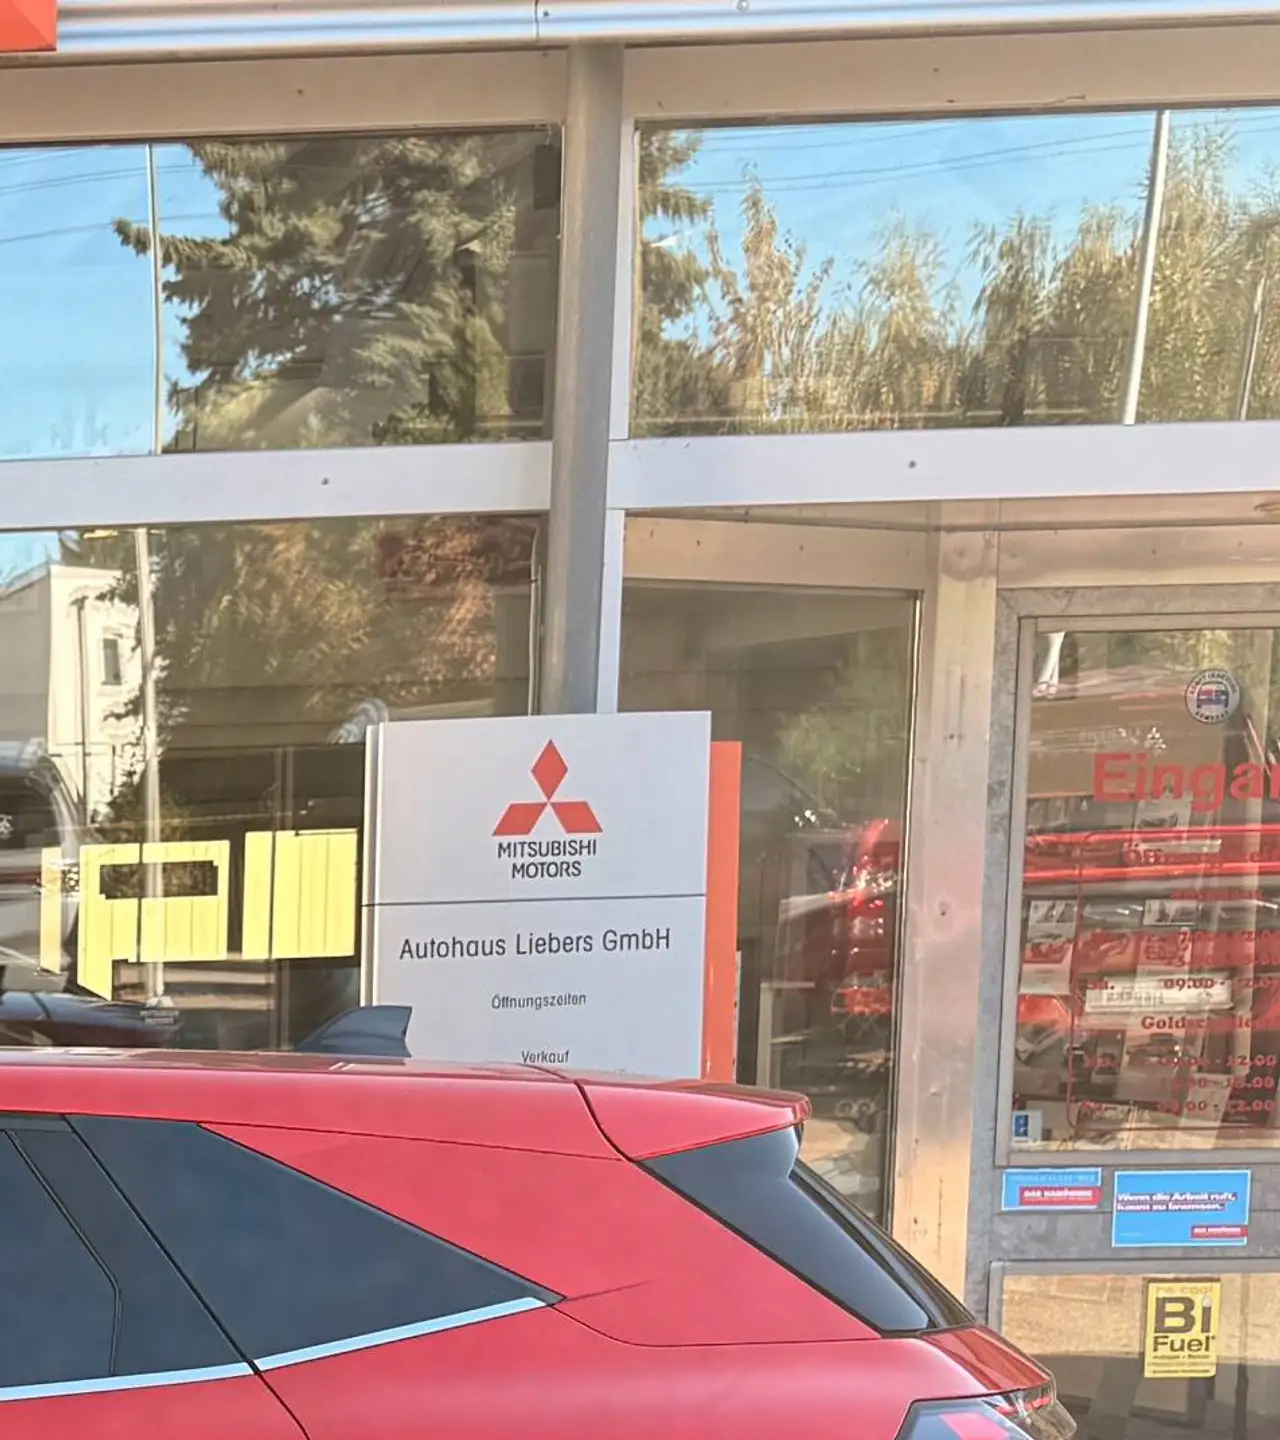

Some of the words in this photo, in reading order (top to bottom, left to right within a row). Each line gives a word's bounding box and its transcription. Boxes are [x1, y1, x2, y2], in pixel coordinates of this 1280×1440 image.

[497, 839, 597, 858] MITSUBISHI
[511, 860, 582, 879] MOTORS
[399, 936, 506, 960] Autohaus
[515, 931, 593, 955] Liebers
[602, 928, 671, 951] GmbH
[490, 993, 587, 1010] Öffnungszeiten
[520, 1050, 569, 1064] Verkauf
[1154, 1296, 1211, 1333] Bi
